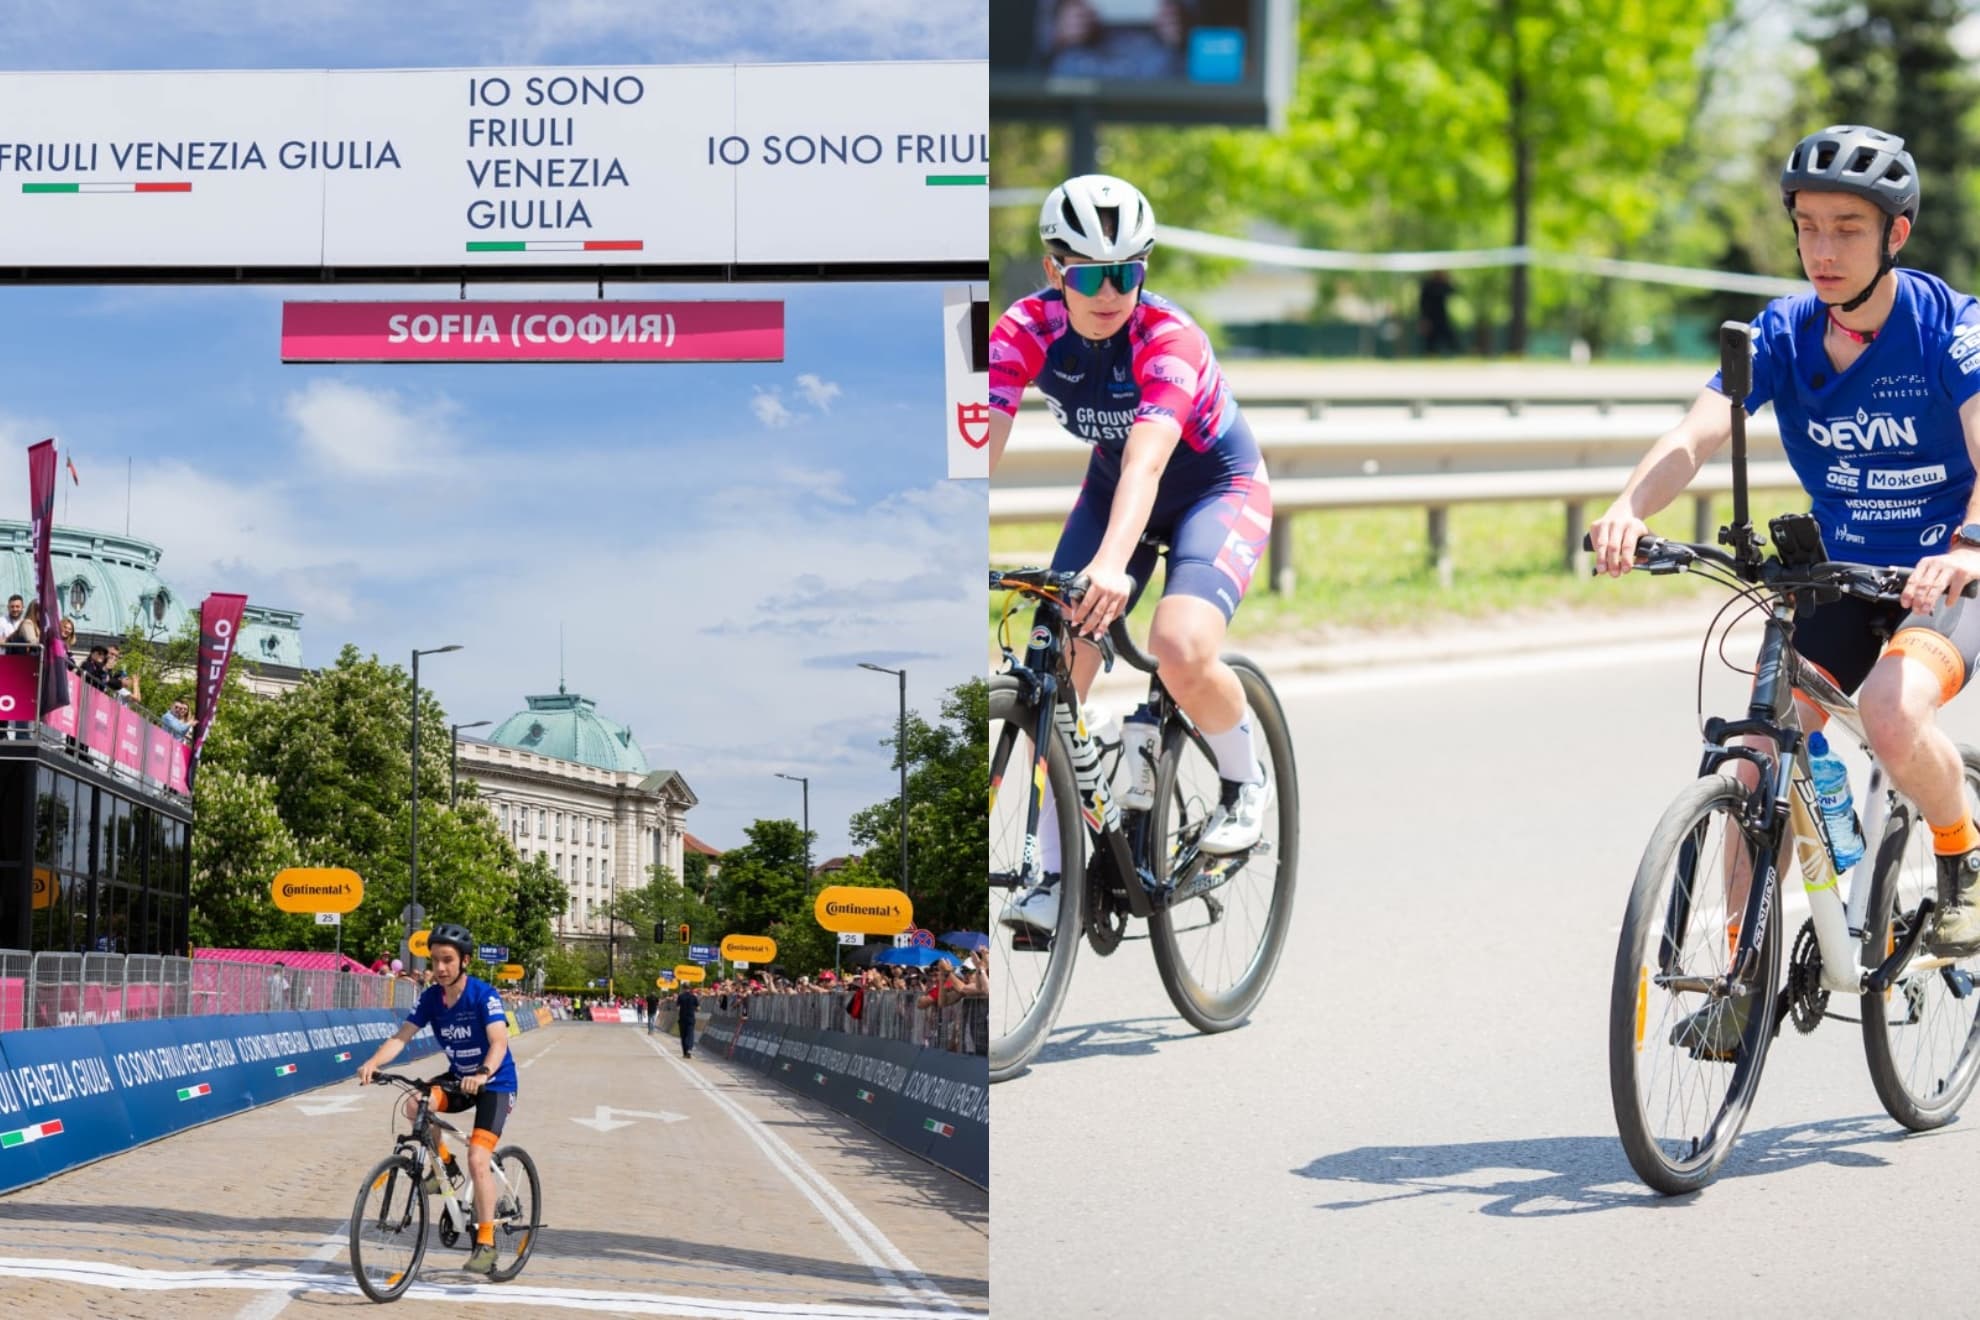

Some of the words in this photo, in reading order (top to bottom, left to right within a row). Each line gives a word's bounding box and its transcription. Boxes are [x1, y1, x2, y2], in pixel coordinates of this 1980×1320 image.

[469, 78, 511, 106] IO
[526, 76, 645, 105] SONO
[468, 118, 574, 147] FRIULI
[0, 142, 98, 172] FRIULI
[110, 141, 268, 171] VENEZIA
[278, 140, 402, 170] GIULIA
[707, 137, 750, 165] IO
[762, 135, 883, 165] SONO
[466, 157, 630, 188] VENEZIA
[466, 199, 593, 229] GIULIA
[387, 313, 501, 344] SOFIA
[510, 313, 677, 348] (СОФИЯ)
[1807, 417, 1919, 451] DEVIN
[1871, 472, 1944, 487] Можеш.
[1851, 507, 1922, 521] МАГАЗИНИ
[282, 883, 342, 898] Continental
[323, 914, 334, 923] 25
[826, 901, 890, 917] Continental
[844, 934, 857, 944] 25
[10, 1062, 79, 1110] VENEZIA
[71, 1056, 115, 1097] GIULIA
[113, 1053, 134, 1089] IO
[128, 1049, 163, 1086] SONO
